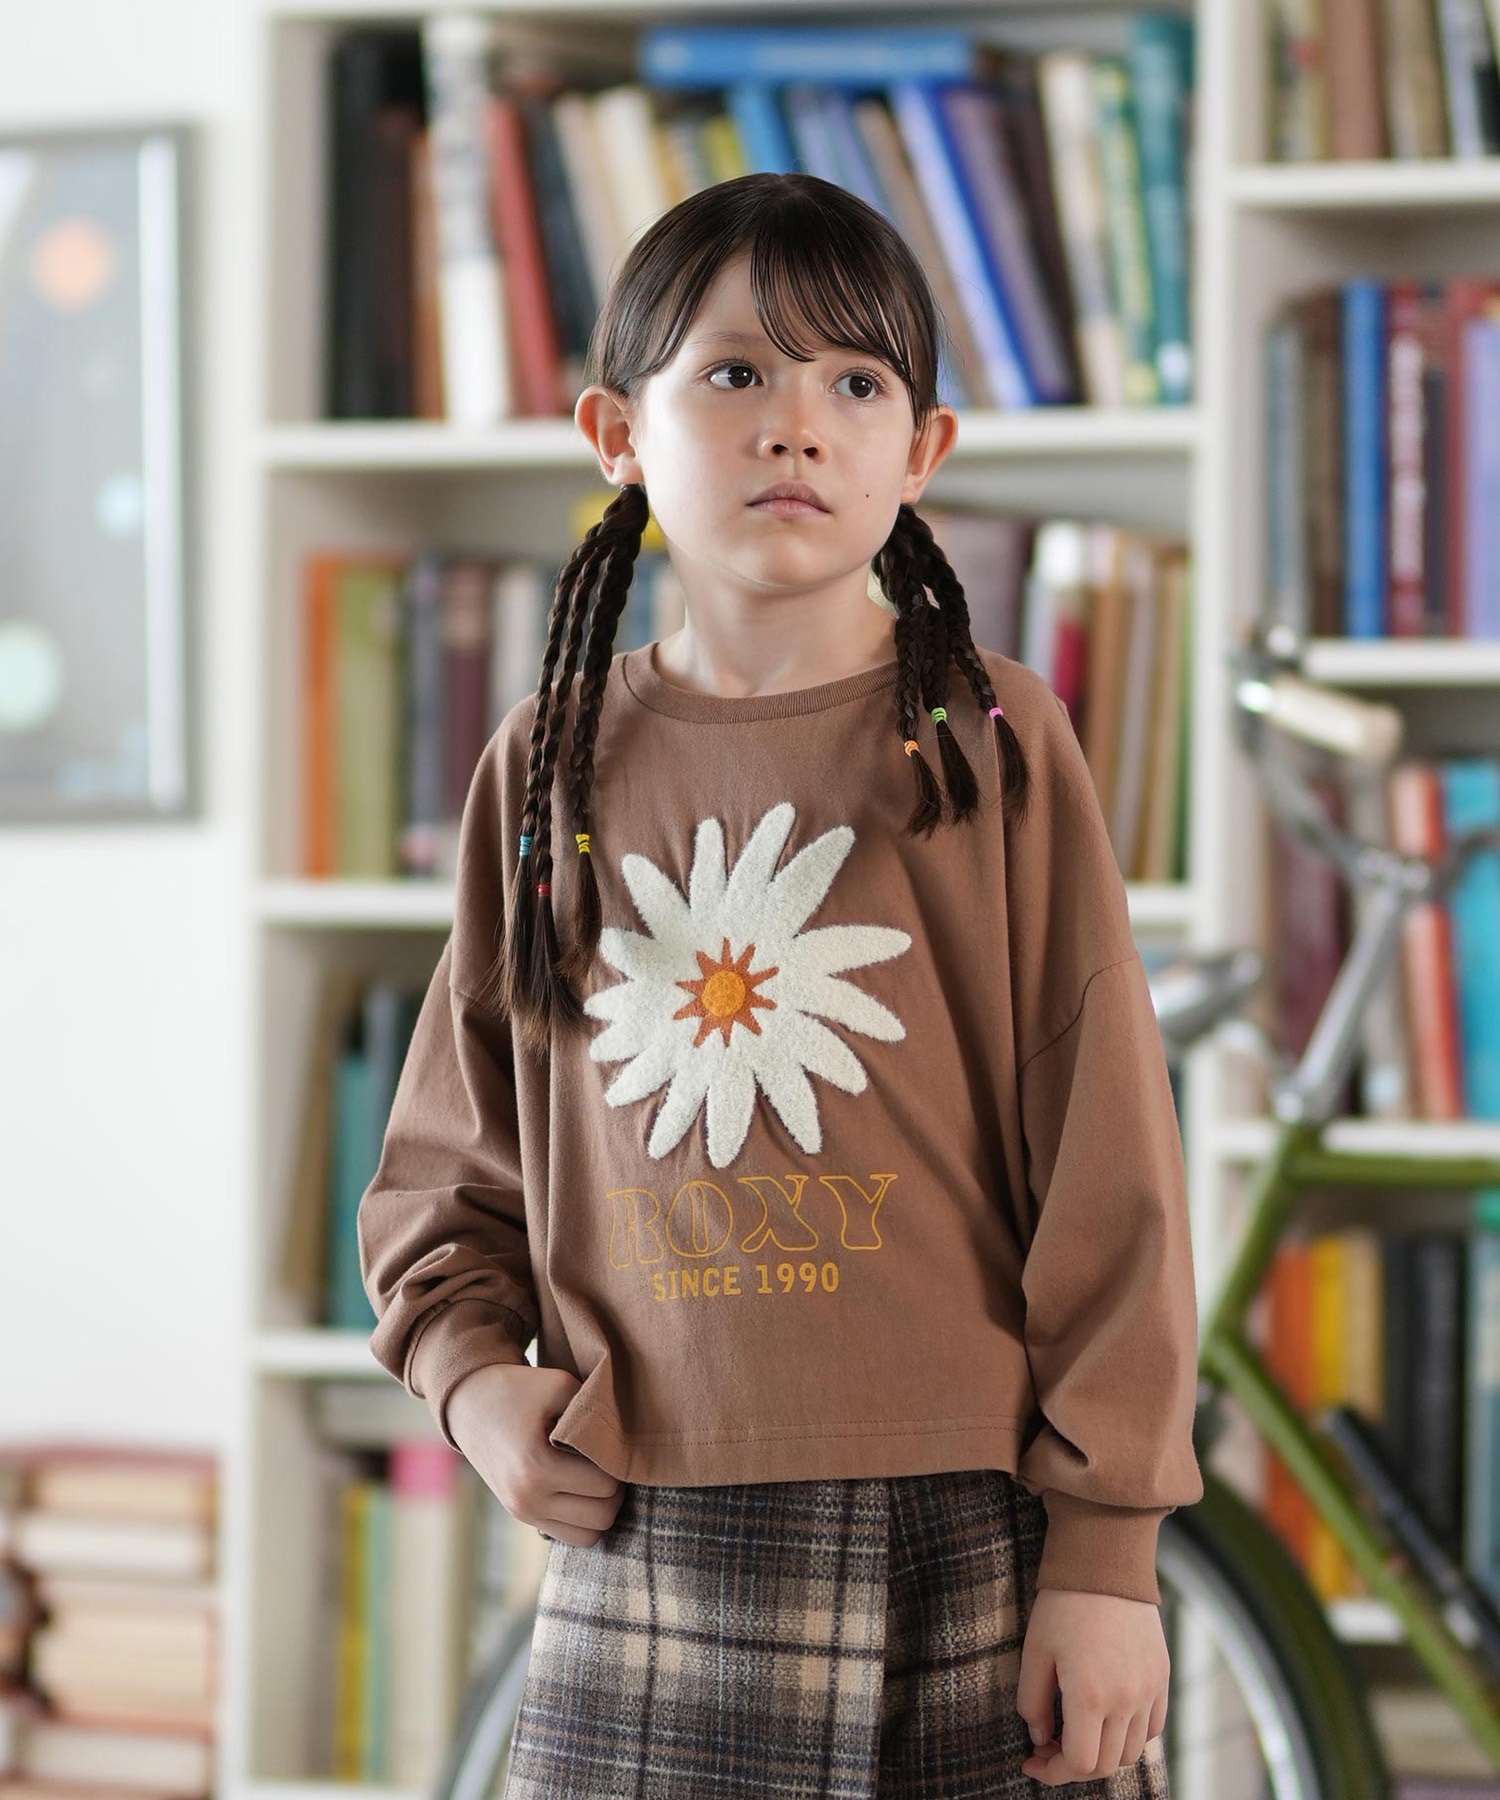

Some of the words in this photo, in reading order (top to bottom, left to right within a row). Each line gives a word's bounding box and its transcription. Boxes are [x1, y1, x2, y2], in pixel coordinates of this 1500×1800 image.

[606, 1173, 898, 1270] ROXY
[652, 1266, 741, 1303] SINCE
[756, 1262, 840, 1295] 1990
